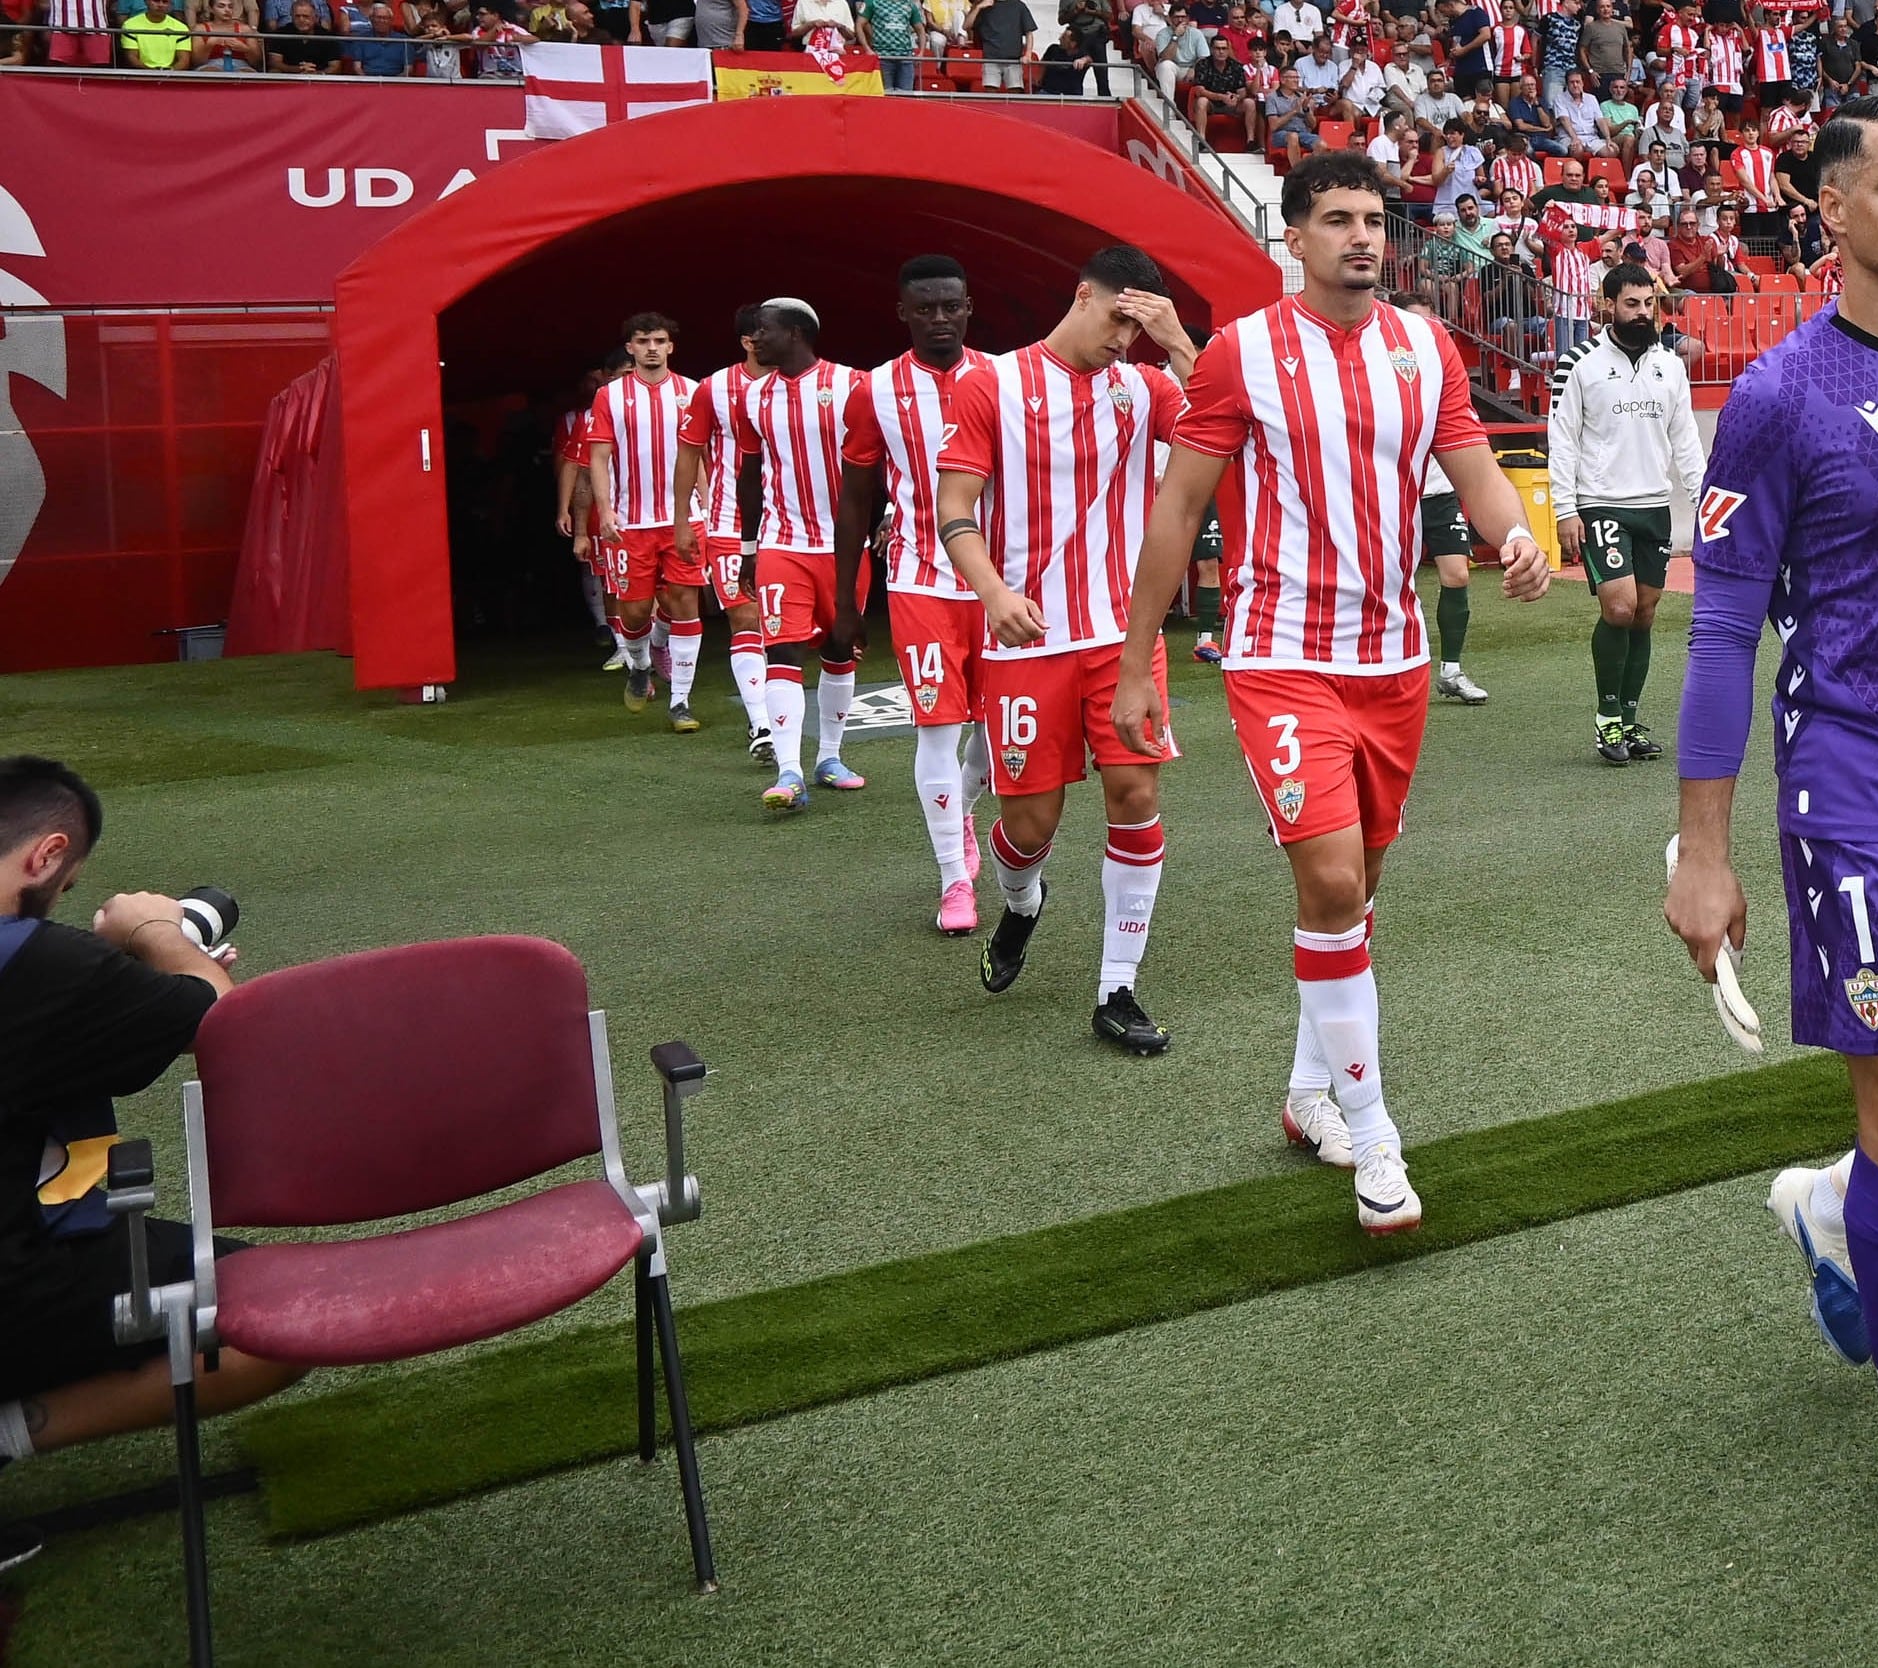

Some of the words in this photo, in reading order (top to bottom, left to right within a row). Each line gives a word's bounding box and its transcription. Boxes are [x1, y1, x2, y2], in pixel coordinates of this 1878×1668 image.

[288, 167, 414, 208] UD
[1591, 519, 1620, 548] 12
[617, 548, 628, 575] 8
[716, 553, 743, 584] 18
[758, 583, 785, 618] 17
[905, 641, 945, 687] 14
[998, 695, 1038, 747] 16
[1266, 713, 1301, 776] 3
[1118, 920, 1147, 934] UDA
[1838, 876, 1876, 965] 1
